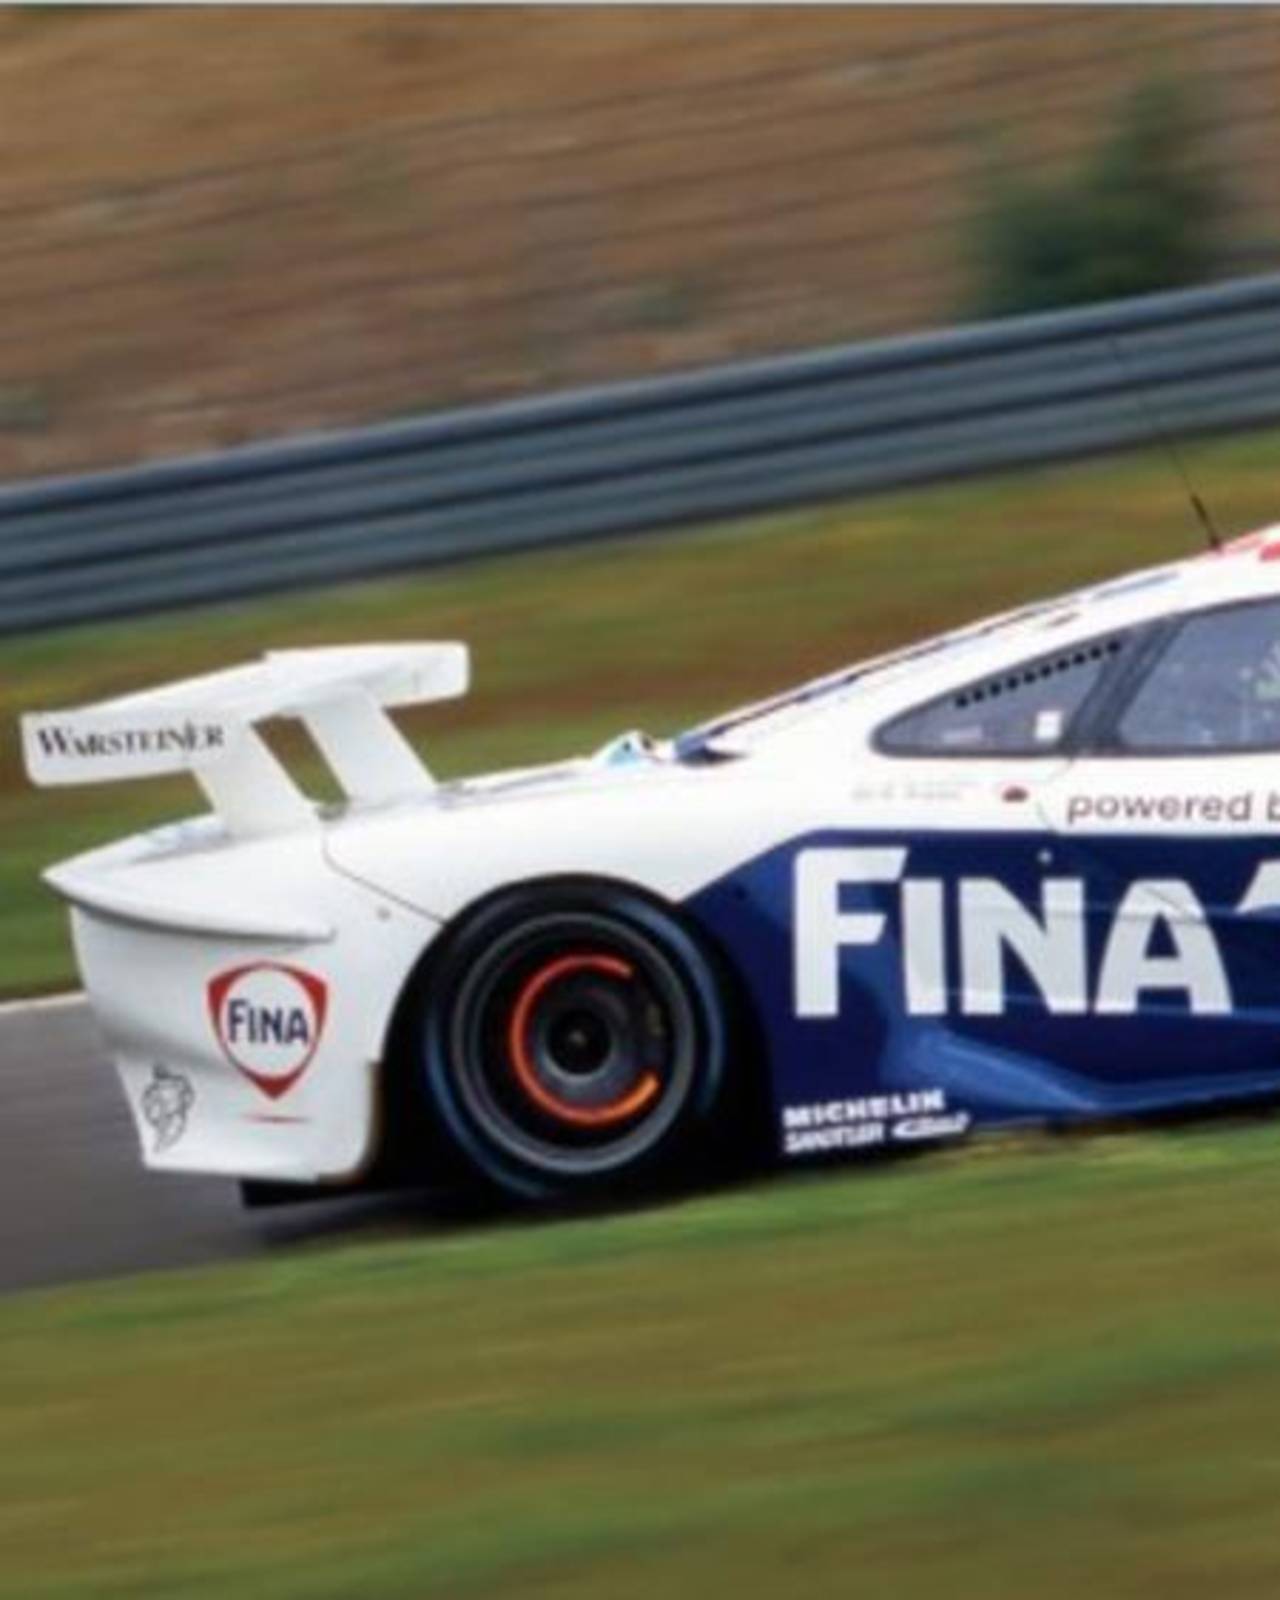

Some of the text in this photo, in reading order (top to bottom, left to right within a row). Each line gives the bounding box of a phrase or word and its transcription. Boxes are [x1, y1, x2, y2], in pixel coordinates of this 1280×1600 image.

[1066, 792, 1254, 824] powered
[795, 846, 1233, 1018] FINA
[227, 998, 309, 1044] FINA
[783, 1088, 945, 1128] MICHELIN
